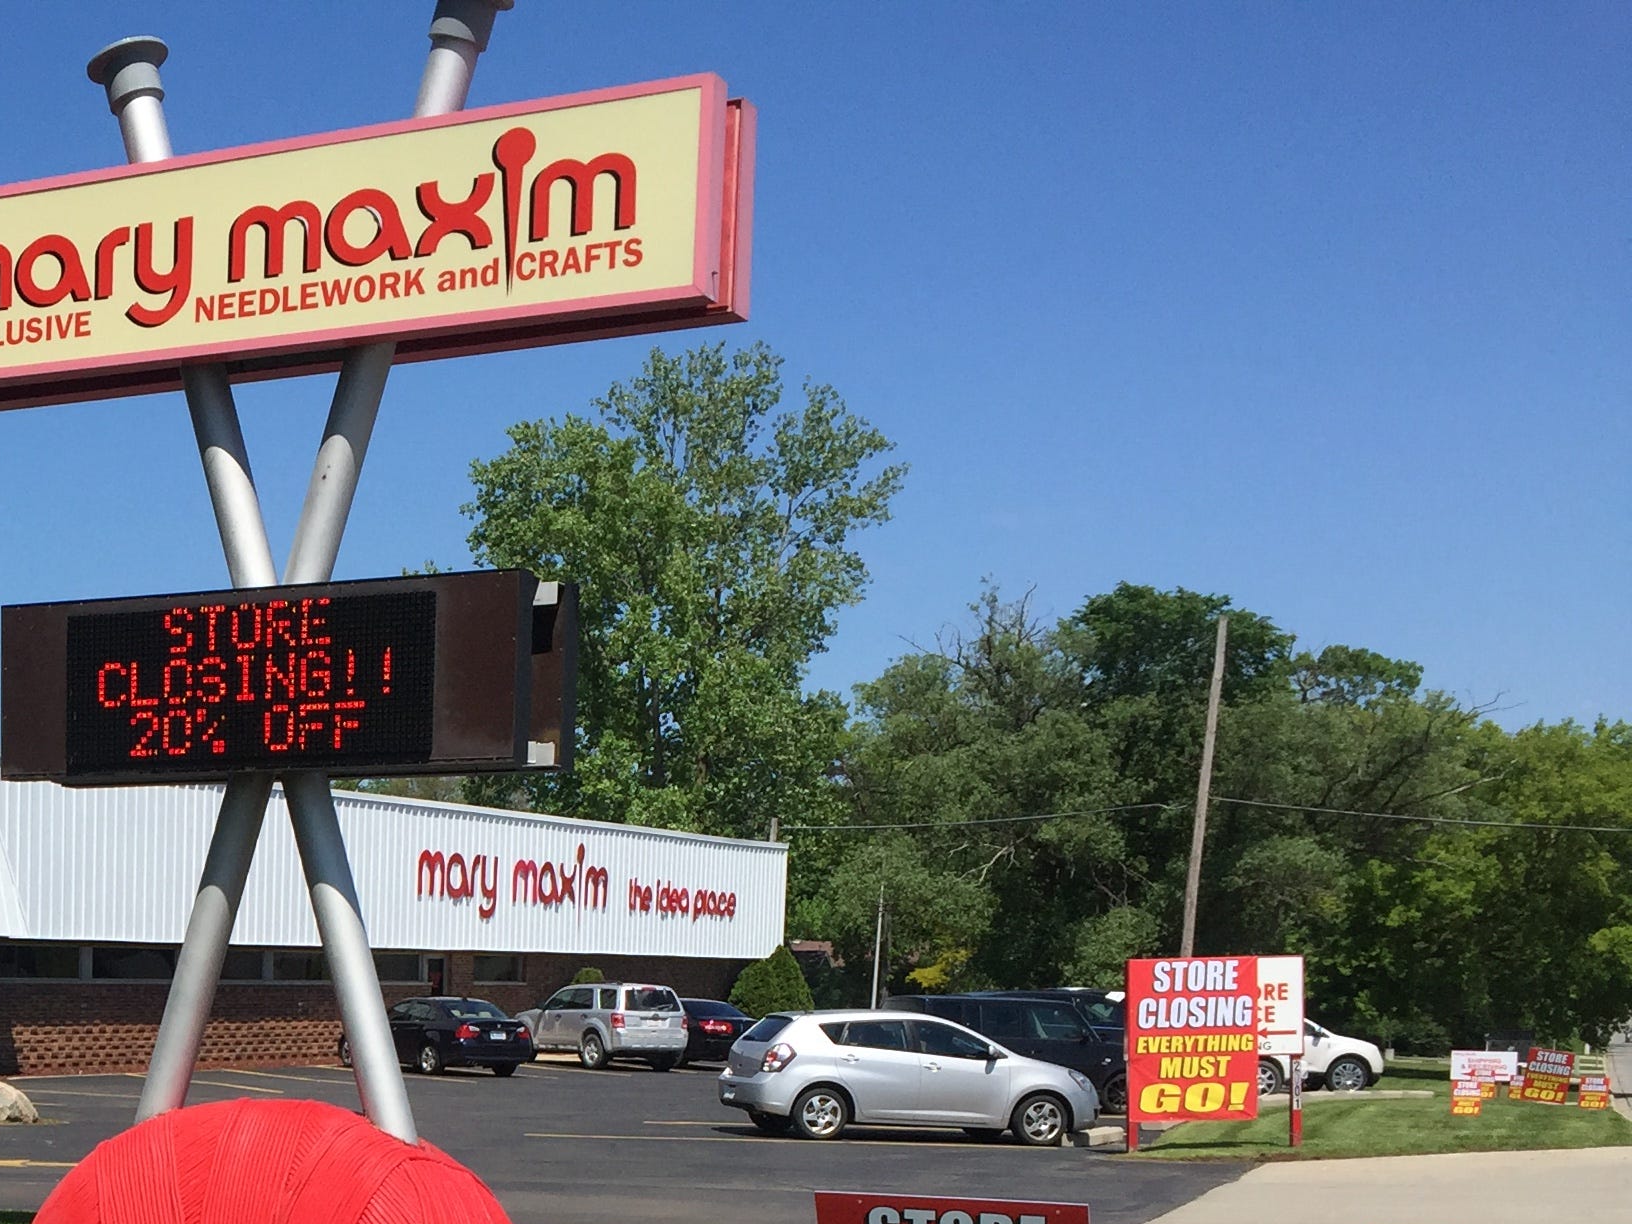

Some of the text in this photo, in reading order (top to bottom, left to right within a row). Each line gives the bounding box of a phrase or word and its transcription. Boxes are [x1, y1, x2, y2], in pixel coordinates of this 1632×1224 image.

[228, 126, 638, 294] maxim
[195, 238, 643, 324] NEEDLEWORK and CRAFTS
[164, 598, 330, 653] STORE
[98, 646, 391, 707] CLOSING!!
[130, 700, 365, 757] 20% OFF
[417, 843, 737, 928] mary maxim the idea place
[1153, 960, 1239, 993] STORE
[1138, 996, 1253, 1029] CLOSING
[1137, 1034, 1253, 1054] EVERYTHING
[1159, 1056, 1231, 1079] MUST
[1139, 1082, 1249, 1114] GO!
[1524, 1087, 1565, 1102] GO!
